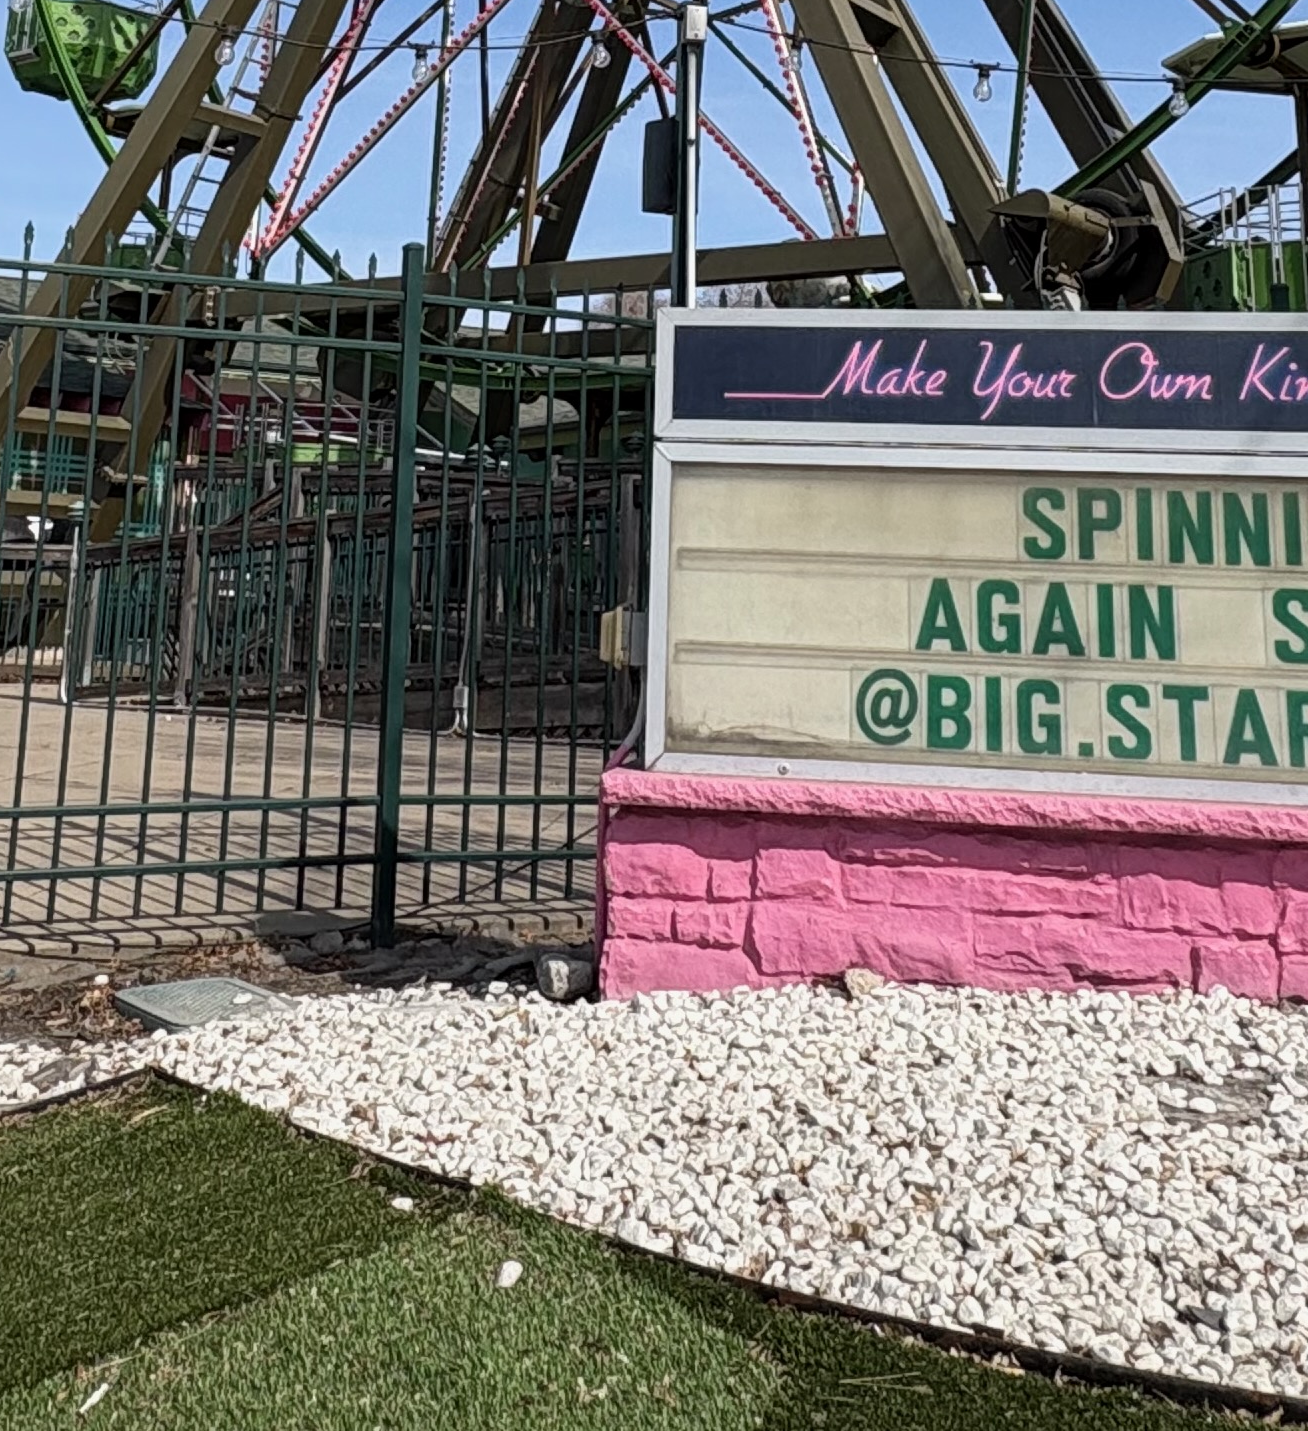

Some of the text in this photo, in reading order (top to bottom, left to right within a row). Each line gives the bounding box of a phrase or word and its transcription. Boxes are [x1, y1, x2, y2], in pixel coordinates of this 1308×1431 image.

[812, 338, 945, 399] Make
[972, 341, 1074, 420] Your
[1098, 342, 1212, 402] Own
[914, 577, 1178, 662] AGAIN
